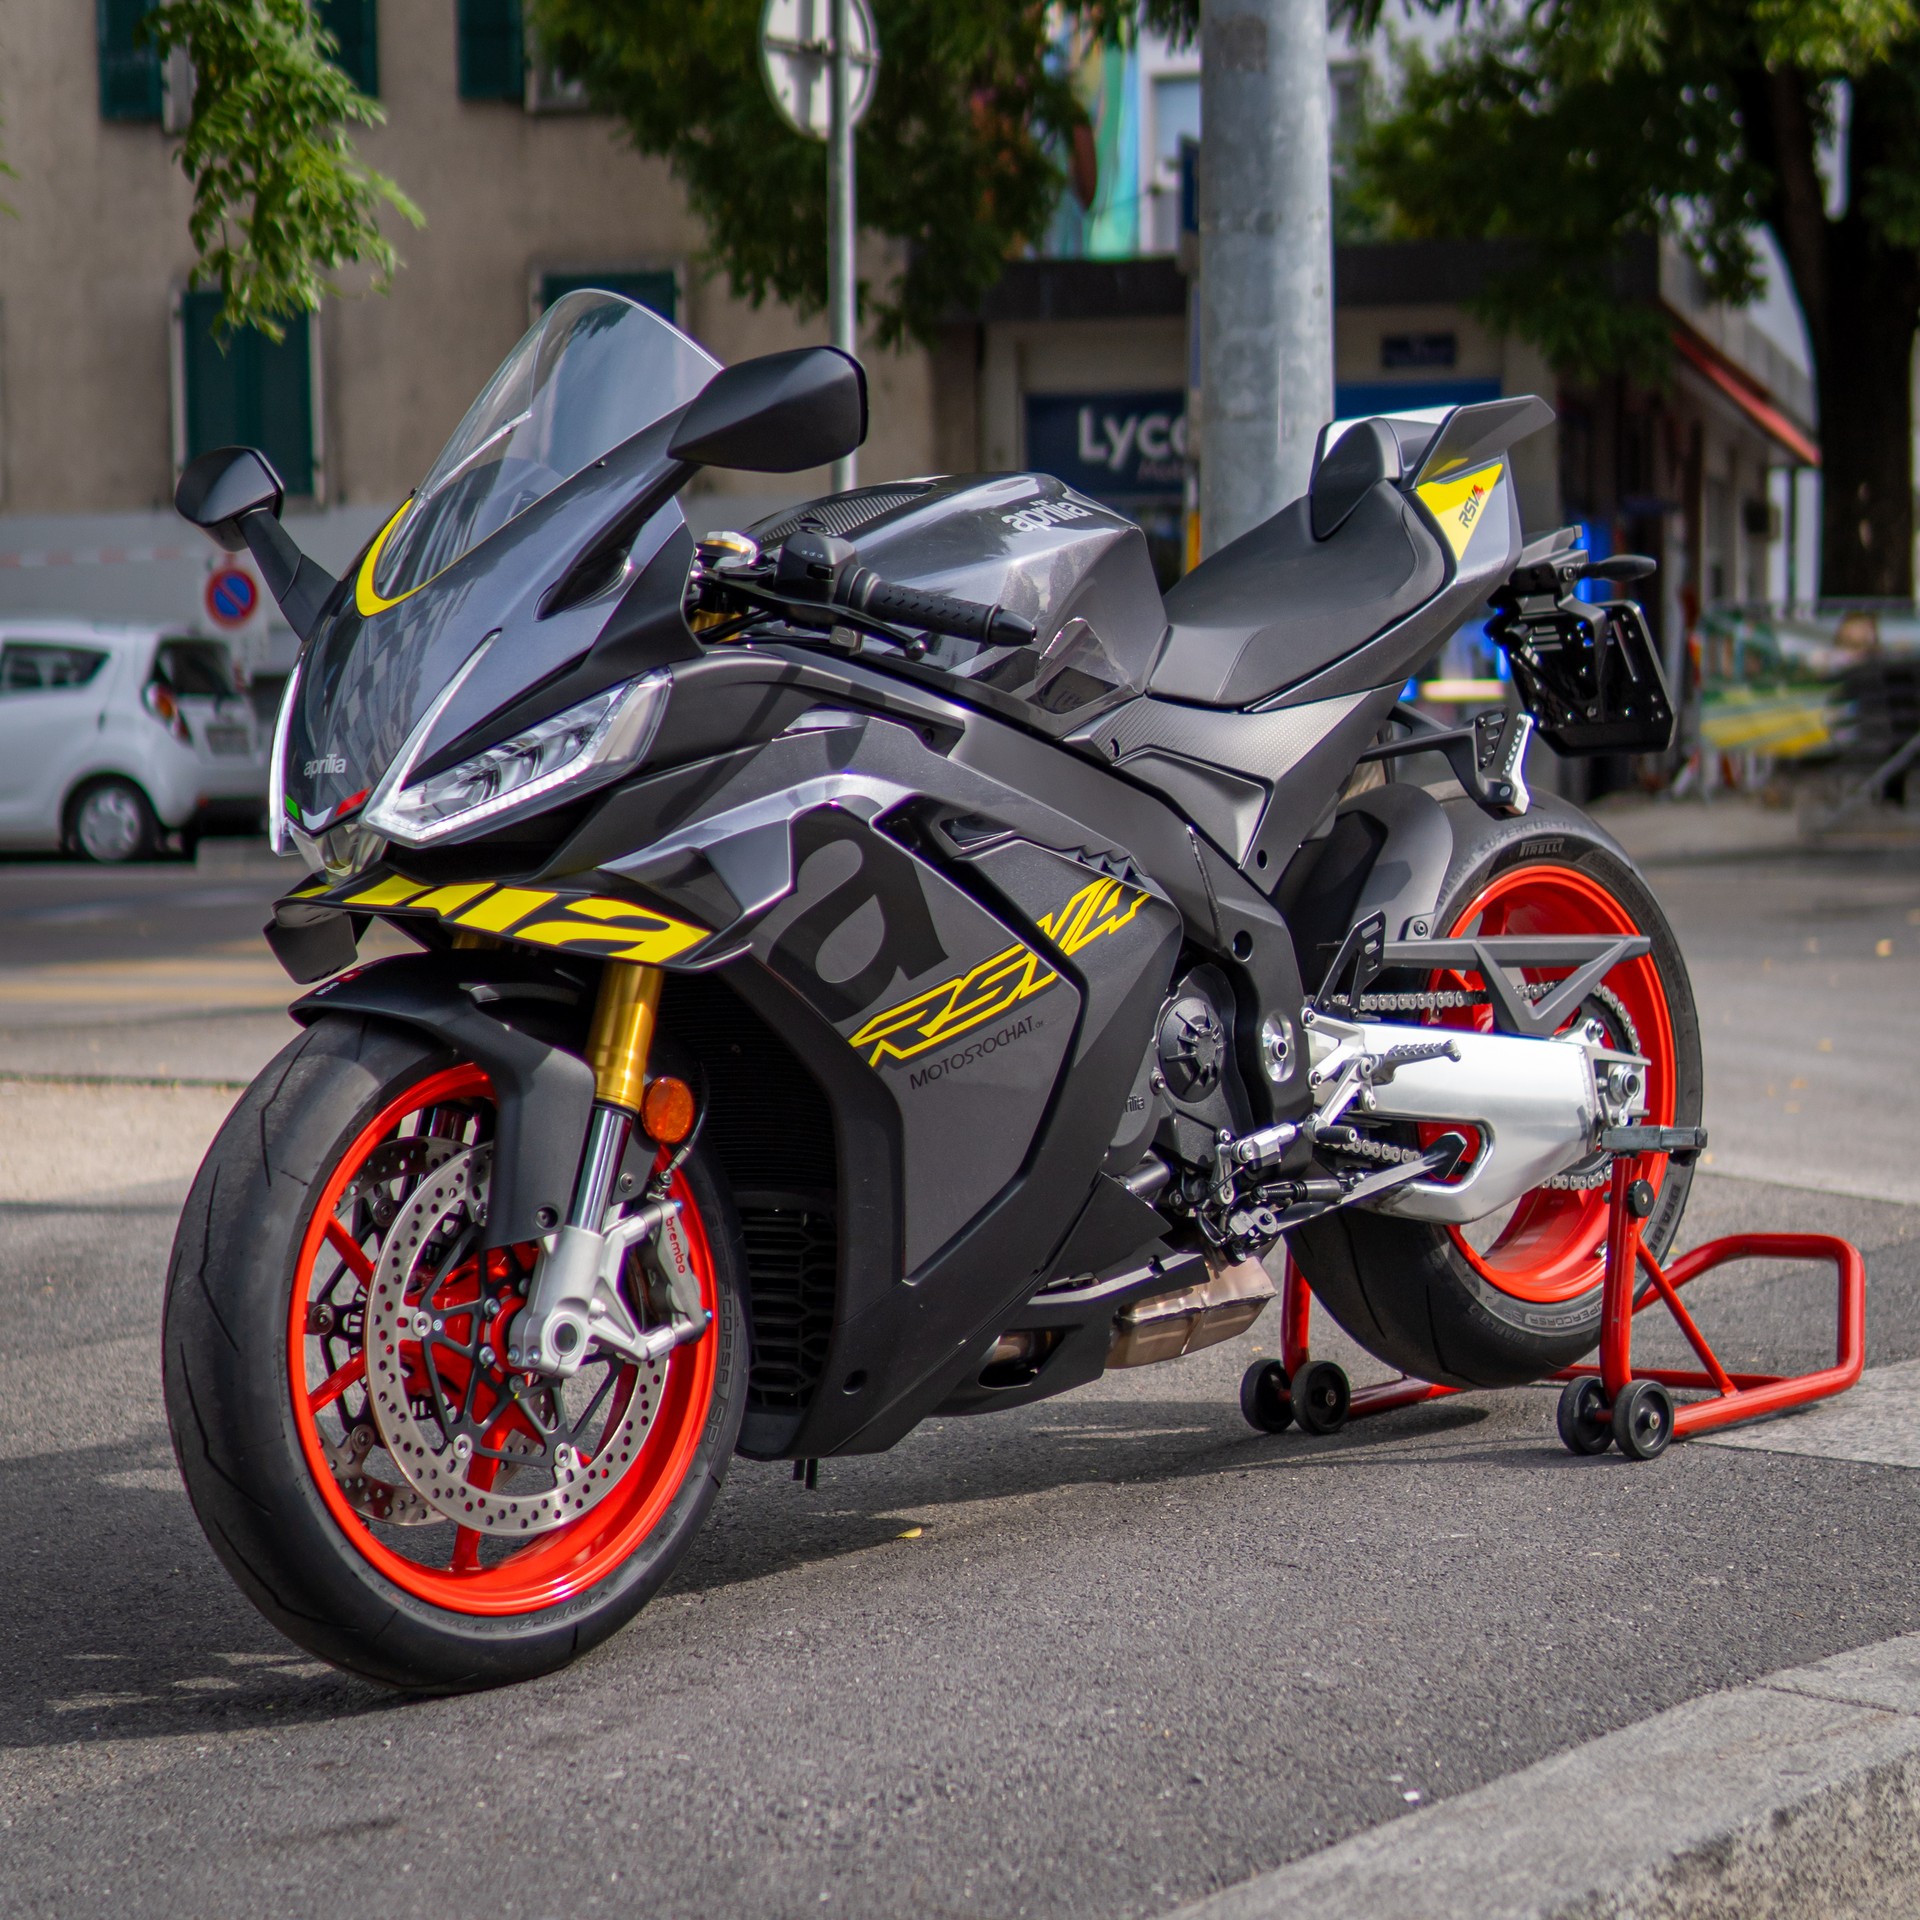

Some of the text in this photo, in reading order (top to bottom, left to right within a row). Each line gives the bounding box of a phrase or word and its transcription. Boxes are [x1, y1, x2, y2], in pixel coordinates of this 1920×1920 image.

[1001, 500, 1094, 532] aprilia
[1459, 484, 1485, 529] RSV4
[303, 753, 347, 779] aprilia
[1519, 838, 1565, 857] PIRELLI
[848, 877, 1152, 1068] RSV4
[1125, 1095, 1145, 1112] rilia
[666, 1216, 686, 1274] brembo
[1531, 1300, 1603, 1326] UPERCORSA
[707, 1404, 725, 1445] SP
